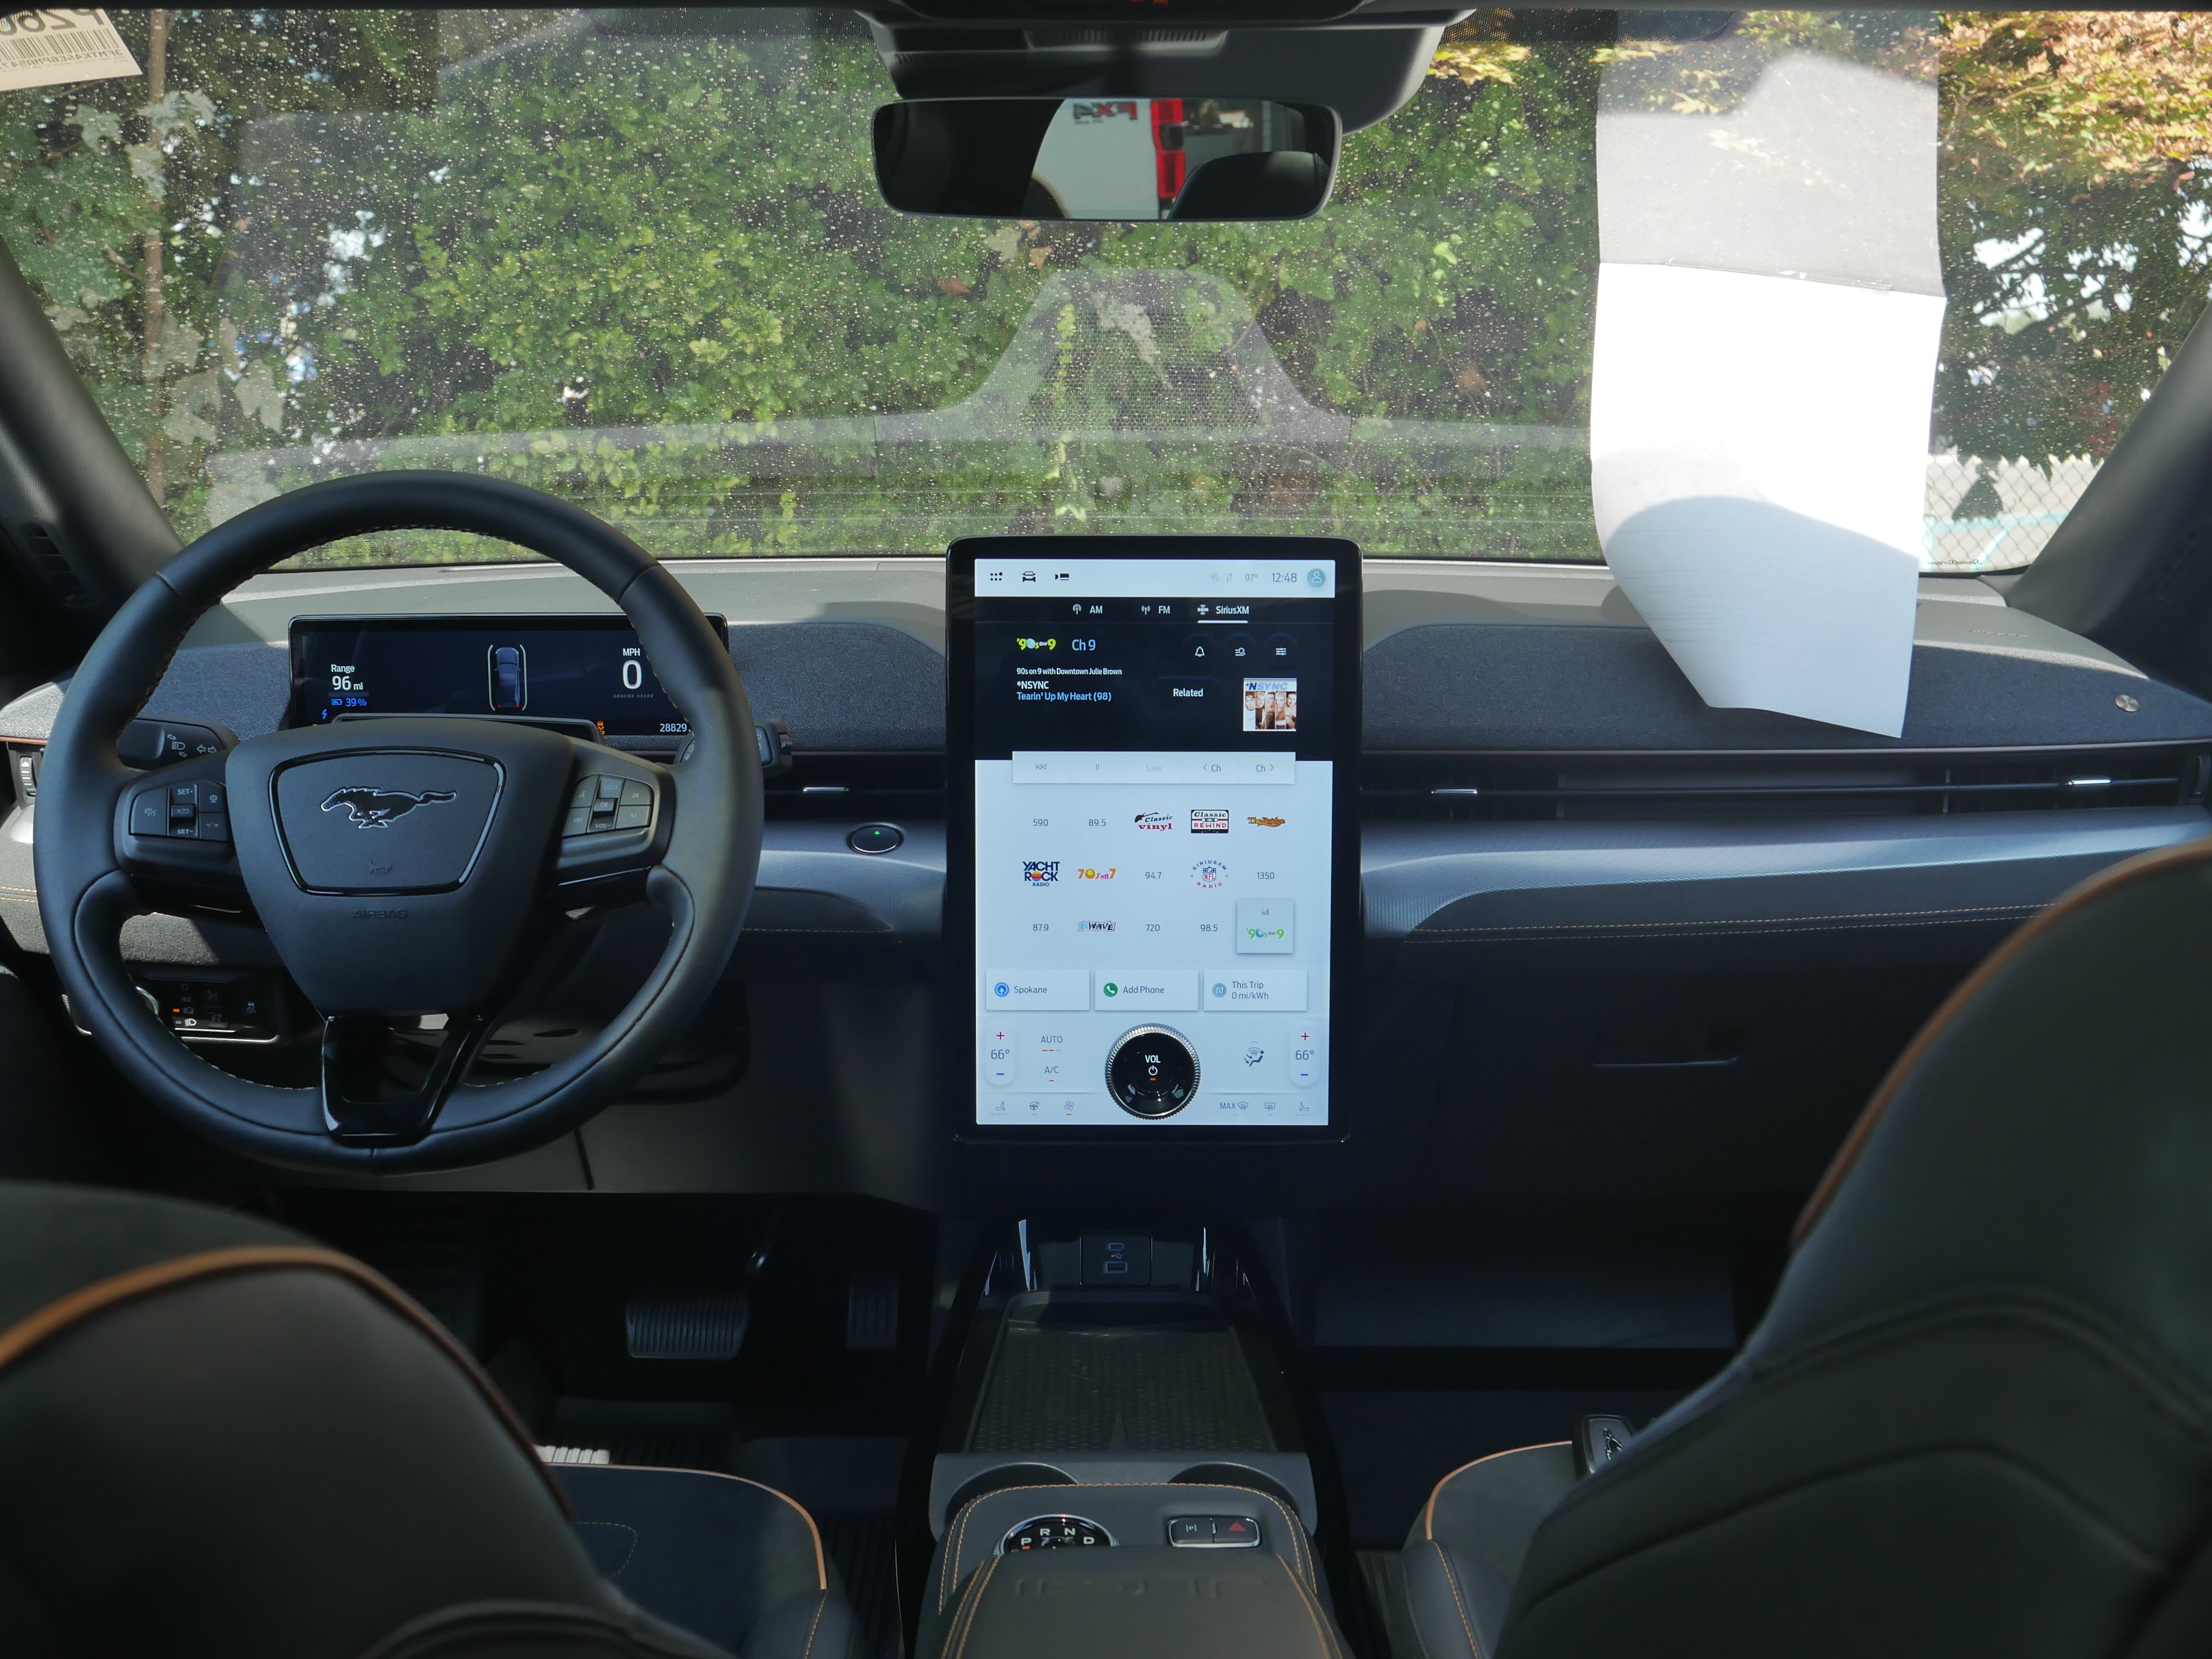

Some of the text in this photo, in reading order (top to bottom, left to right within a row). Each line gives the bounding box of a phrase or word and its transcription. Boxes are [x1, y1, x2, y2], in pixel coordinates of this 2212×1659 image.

[1244, 574, 1258, 582] 97°
[1272, 573, 1297, 582] 12:48
[1090, 605, 1103, 614] AM
[1158, 605, 1170, 614] FM
[1216, 605, 1250, 615] SiriusXM
[1072, 639, 1096, 651] Ch 9
[623, 647, 641, 656] MPH
[331, 664, 355, 674] Range
[622, 659, 642, 690] 0
[332, 676, 363, 691] 96 mi
[1016, 691, 1112, 702] Tearin' Up My Heart (98)
[1173, 688, 1204, 697] Related
[346, 697, 357, 707] 39
[1211, 764, 1222, 772] Ch
[1256, 764, 1266, 772] Ch
[1088, 819, 1107, 827] 89.5
[1145, 814, 1173, 823] Classic
[1138, 823, 1172, 832] vinyl
[1023, 861, 1060, 871] YACHT
[1192, 860, 1227, 871] SIRIUSXM
[1025, 871, 1059, 882] ROCK
[1145, 871, 1162, 879] 94.7
[1033, 923, 1049, 931] 87.9
[1088, 922, 1114, 931] WAVE
[1014, 986, 1047, 994] Spokane
[1249, 981, 1264, 990] Trip
[1239, 992, 1269, 1000] mi/kWh
[1145, 1055, 1161, 1064] VOL
[1020, 1528, 1095, 1546] P R N D
